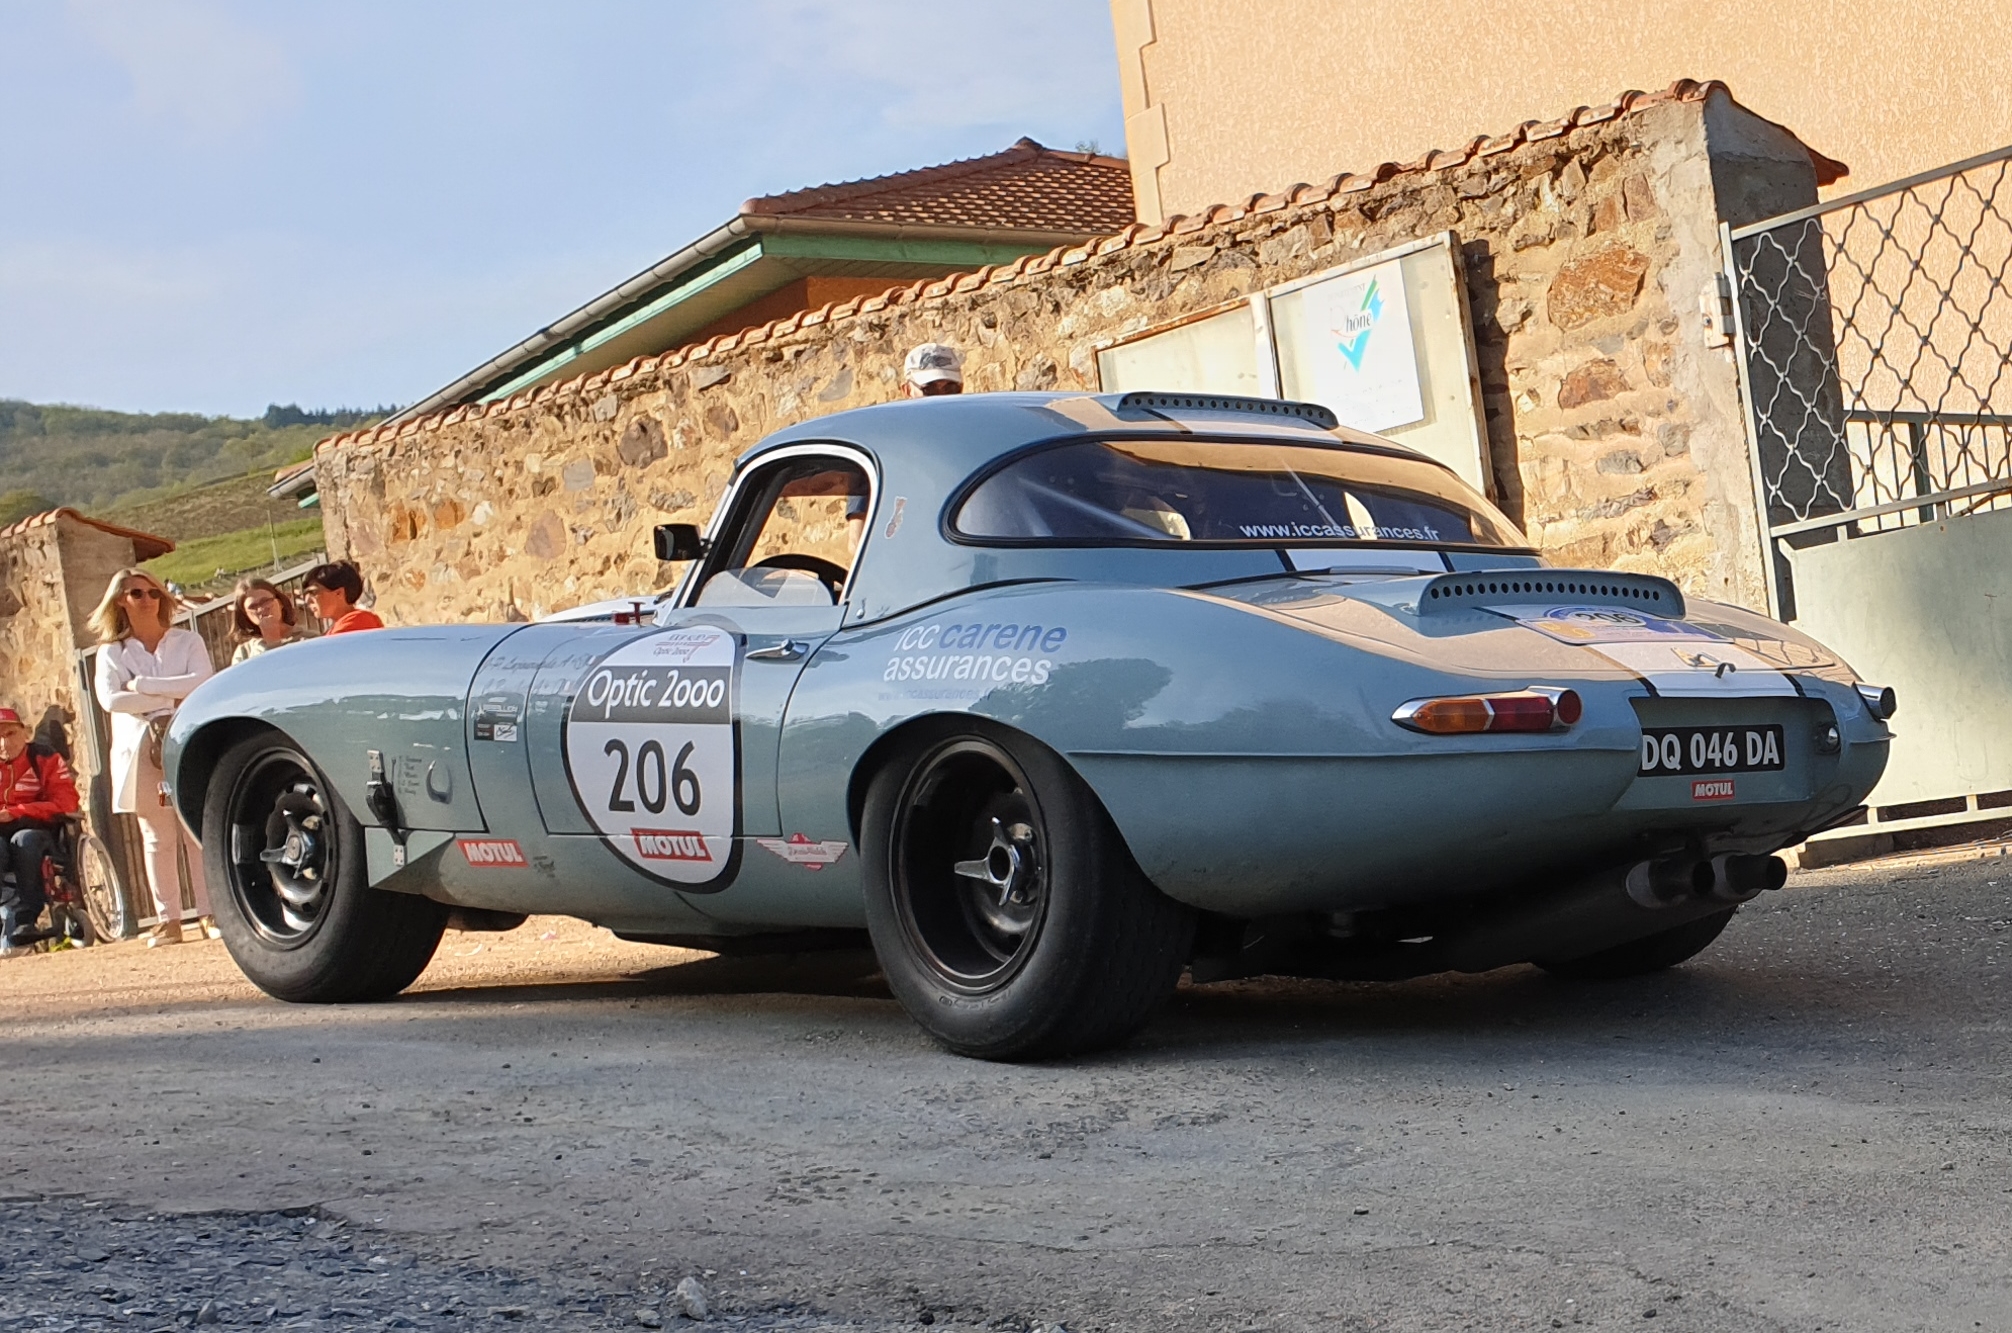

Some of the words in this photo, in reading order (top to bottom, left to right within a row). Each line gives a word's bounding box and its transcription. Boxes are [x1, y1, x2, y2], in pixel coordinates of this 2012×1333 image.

[1239, 521, 1439, 541] www.iccassurances.fr
[939, 623, 1067, 653] carene
[883, 653, 1052, 685] assurances
[588, 669, 658, 719] Optic
[658, 669, 726, 708] 2000
[1641, 733, 1682, 771] DQ
[1690, 732, 1738, 768] 046
[1746, 730, 1780, 766] DA
[604, 738, 702, 816] 206
[1694, 782, 1733, 797] MOTUL
[463, 842, 524, 863] MOTUL
[639, 835, 707, 857] MOTUL
